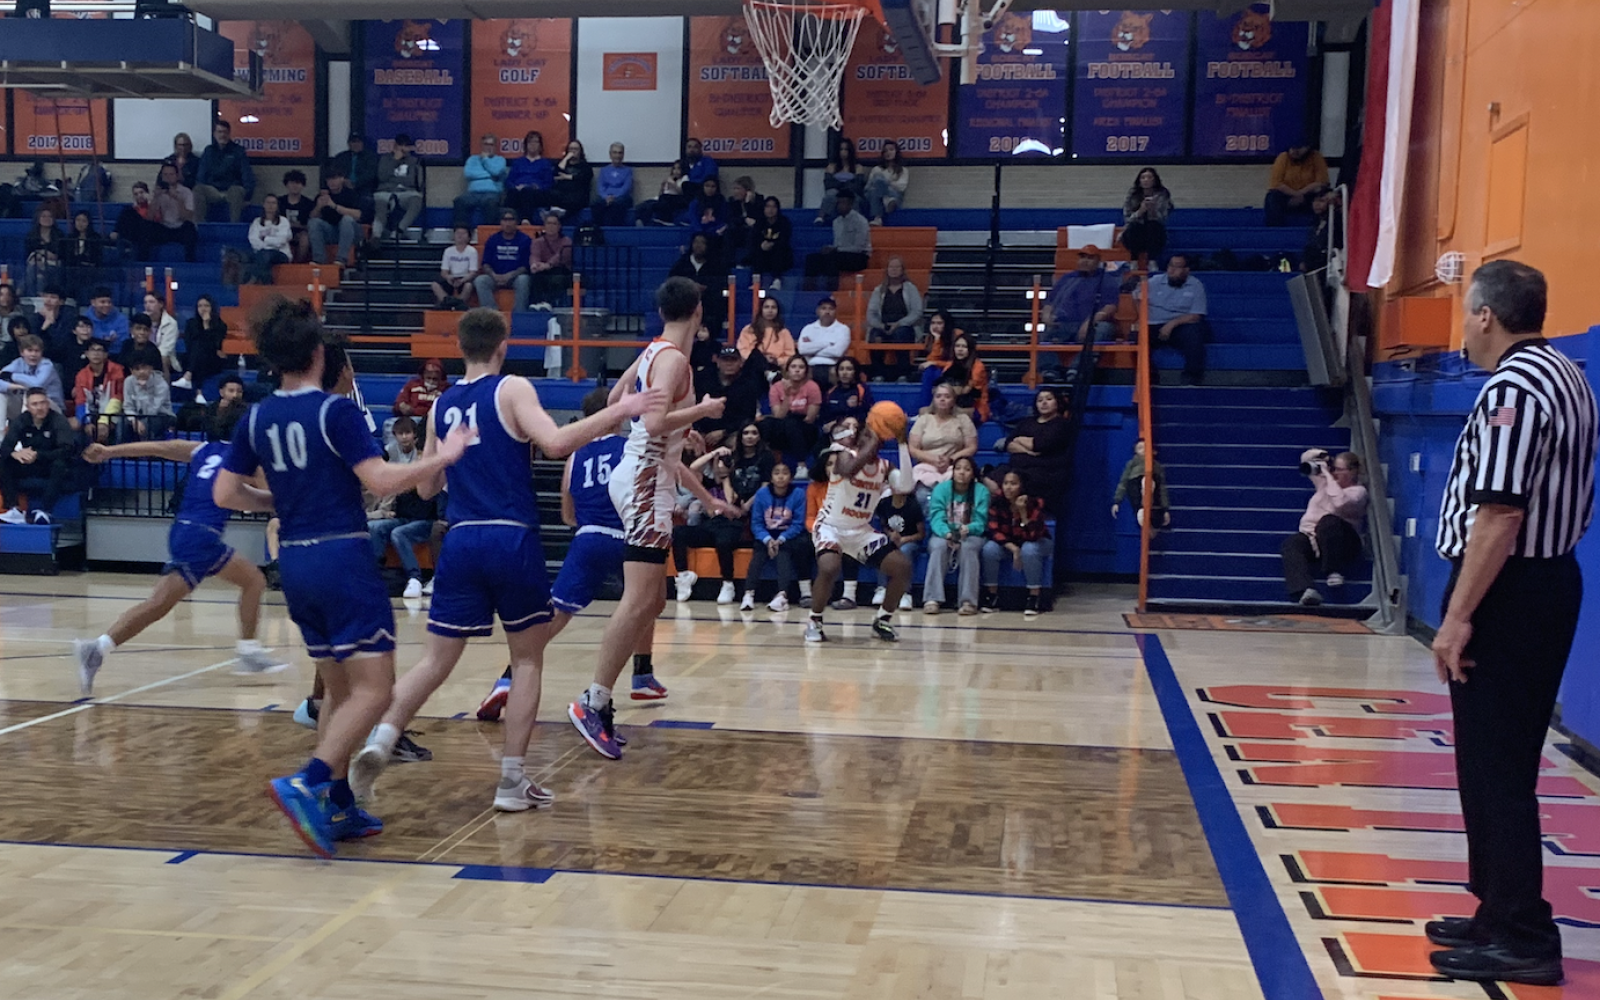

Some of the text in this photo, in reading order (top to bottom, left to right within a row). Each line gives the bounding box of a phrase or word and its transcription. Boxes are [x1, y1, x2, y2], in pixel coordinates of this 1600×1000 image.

[374, 69, 453, 85] BASEBALL
[499, 68, 540, 83] GOLF
[700, 66, 771, 82] SOFTBAL
[1087, 62, 1175, 78] FOOTBALL
[1206, 61, 1295, 78] FOOTBALL
[703, 138, 775, 152] 2017-2018
[1106, 136, 1149, 152] 2017
[1225, 135, 1269, 151] 2018
[443, 402, 481, 446] 21
[265, 421, 308, 472] 10
[582, 453, 612, 488] 15
[854, 491, 871, 509] 21
